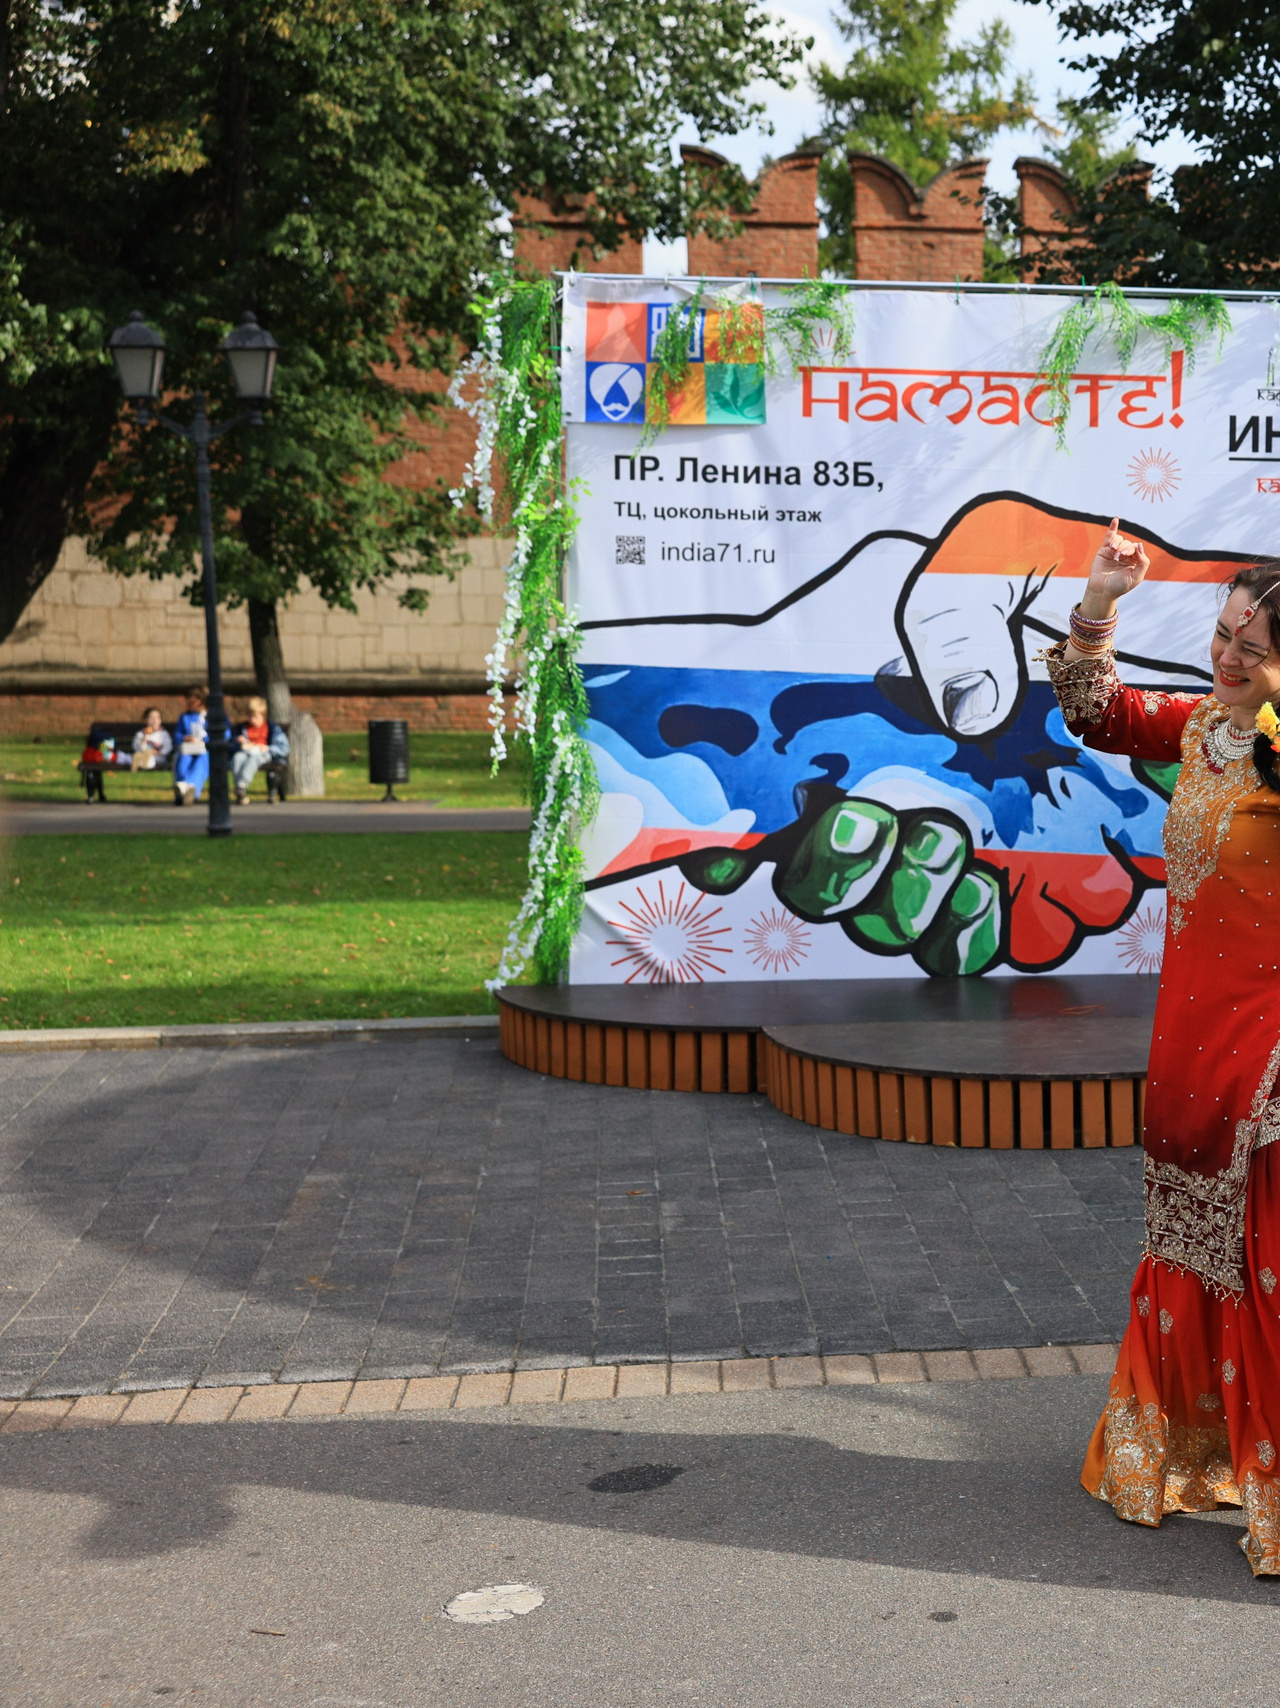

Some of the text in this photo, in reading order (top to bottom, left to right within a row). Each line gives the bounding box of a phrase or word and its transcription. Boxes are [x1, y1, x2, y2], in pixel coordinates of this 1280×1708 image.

[614, 454, 884, 493] ПР. Ленина 83Б,
[613, 501, 822, 523] ТЦ, цокольный этаж
[661, 541, 776, 563] india71.ru
